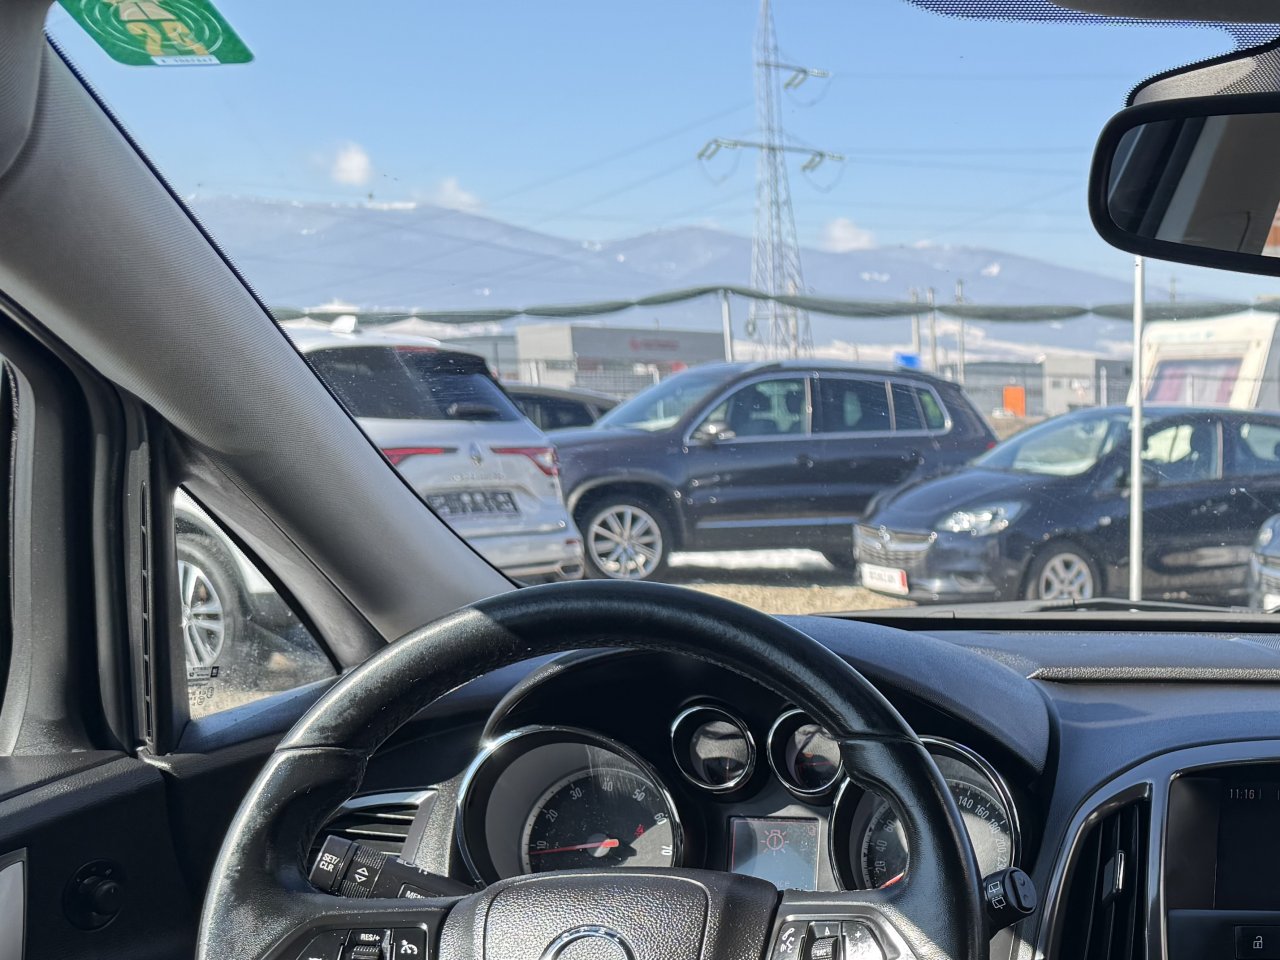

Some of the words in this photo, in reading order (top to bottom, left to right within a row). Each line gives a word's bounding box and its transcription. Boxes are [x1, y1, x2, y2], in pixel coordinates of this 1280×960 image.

[601, 781, 613, 792] 40
[569, 787, 583, 800] 30
[632, 788, 646, 802] 50
[1230, 788, 1255, 800] 11:16
[958, 796, 974, 809] 140
[545, 809, 559, 823] 20
[974, 804, 990, 819] 160
[654, 812, 668, 825] 60
[882, 819, 897, 833] 60
[987, 818, 1001, 834] 180
[537, 840, 547, 850] 10
[661, 844, 673, 856] 70
[875, 839, 888, 852] 40
[995, 837, 1007, 853] 200
[319, 861, 335, 872] CLR
[874, 860, 886, 872] 20
